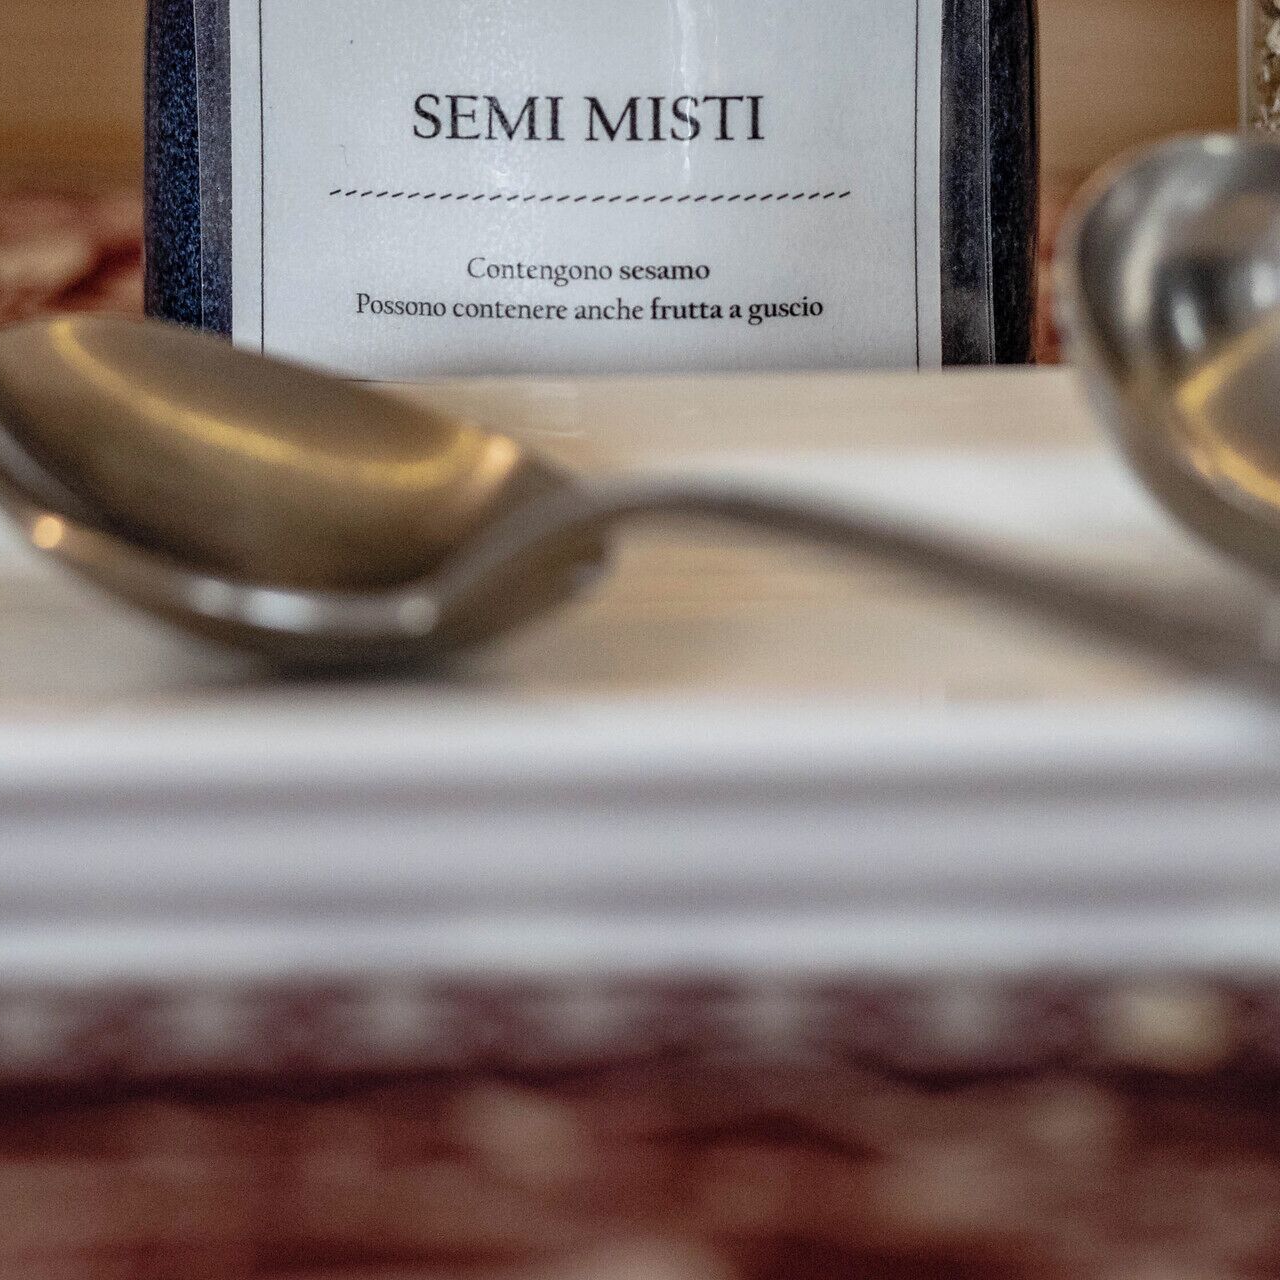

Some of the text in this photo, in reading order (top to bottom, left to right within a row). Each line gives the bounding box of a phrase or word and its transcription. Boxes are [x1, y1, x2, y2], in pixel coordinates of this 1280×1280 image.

[412, 92, 766, 142] SEMI MISTI
[466, 256, 711, 287] Contengono sesamo
[355, 292, 825, 326] Possono contenere anche frutta a guscio
